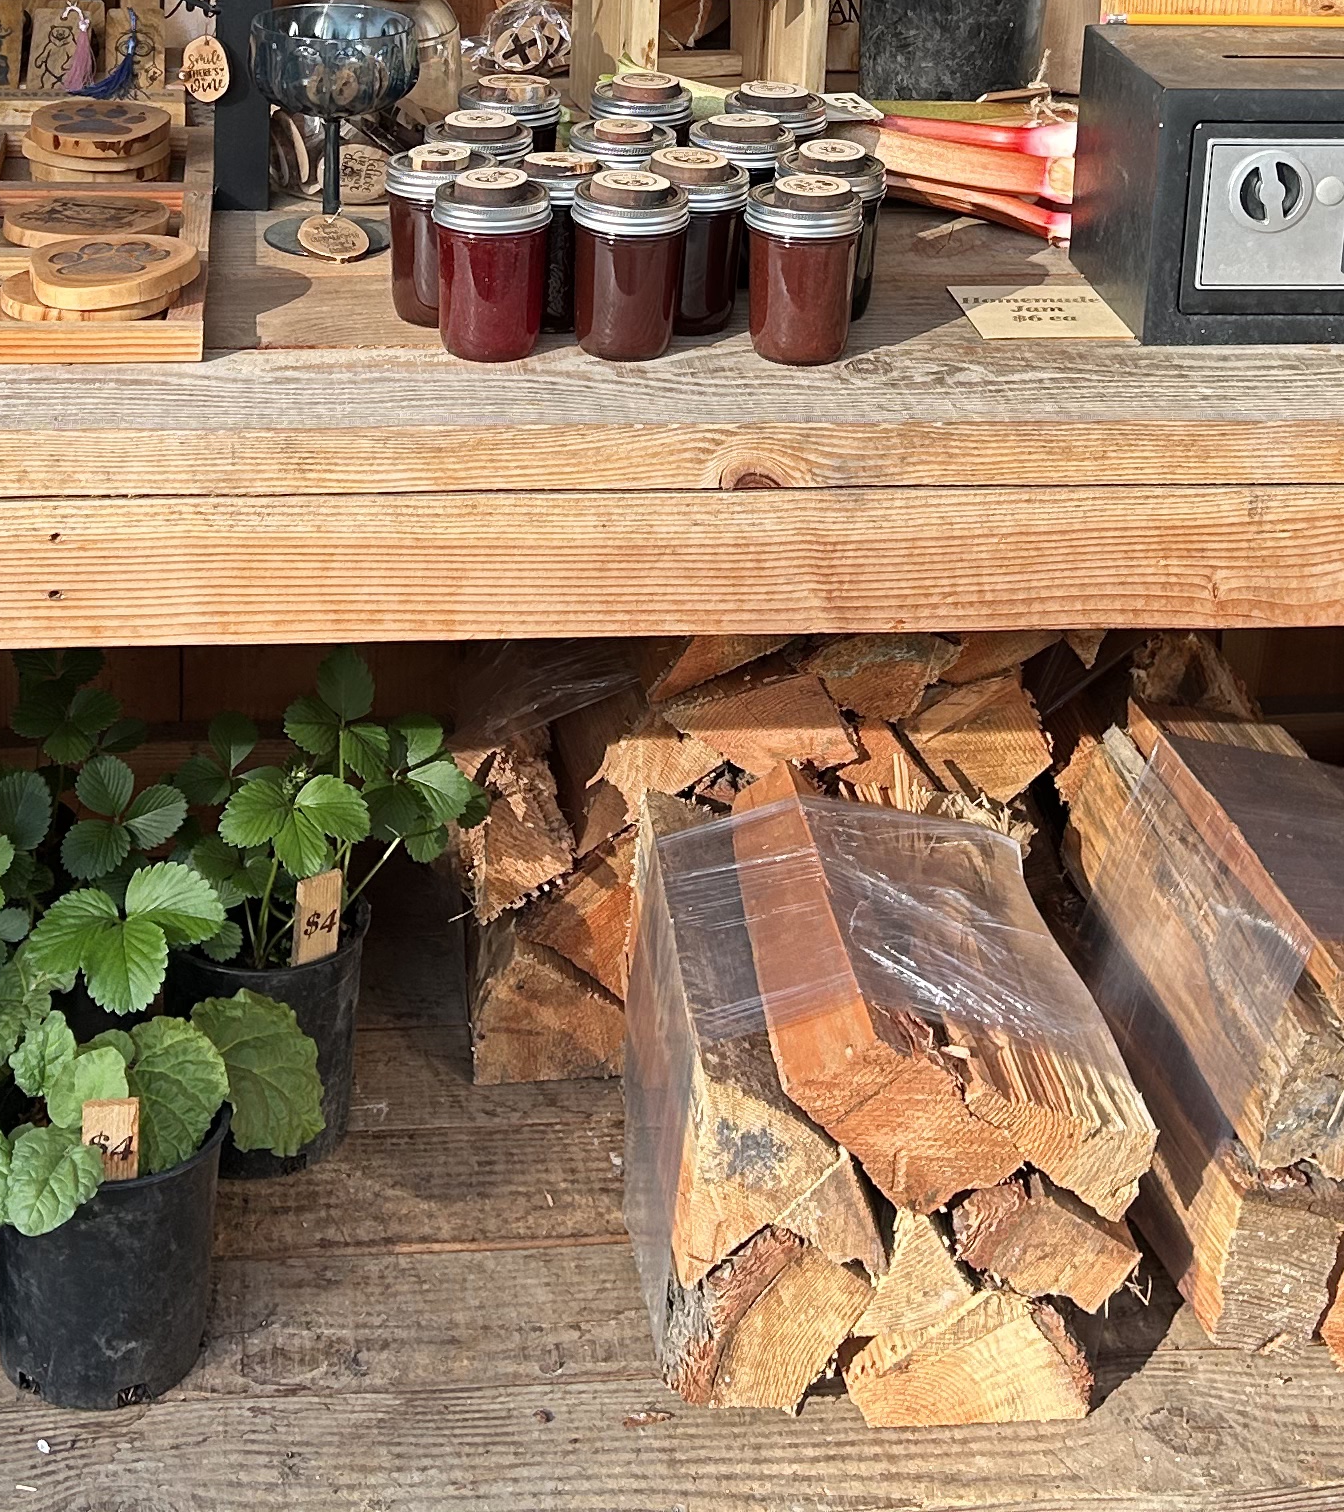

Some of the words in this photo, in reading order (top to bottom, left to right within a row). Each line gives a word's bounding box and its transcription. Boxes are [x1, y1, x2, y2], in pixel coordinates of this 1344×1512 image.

[963, 296, 1100, 305] Homemade
[1010, 305, 1065, 313] Jam
[1012, 314, 1043, 323] $6
[303, 908, 337, 939] $4
[89, 1130, 134, 1161] $4
